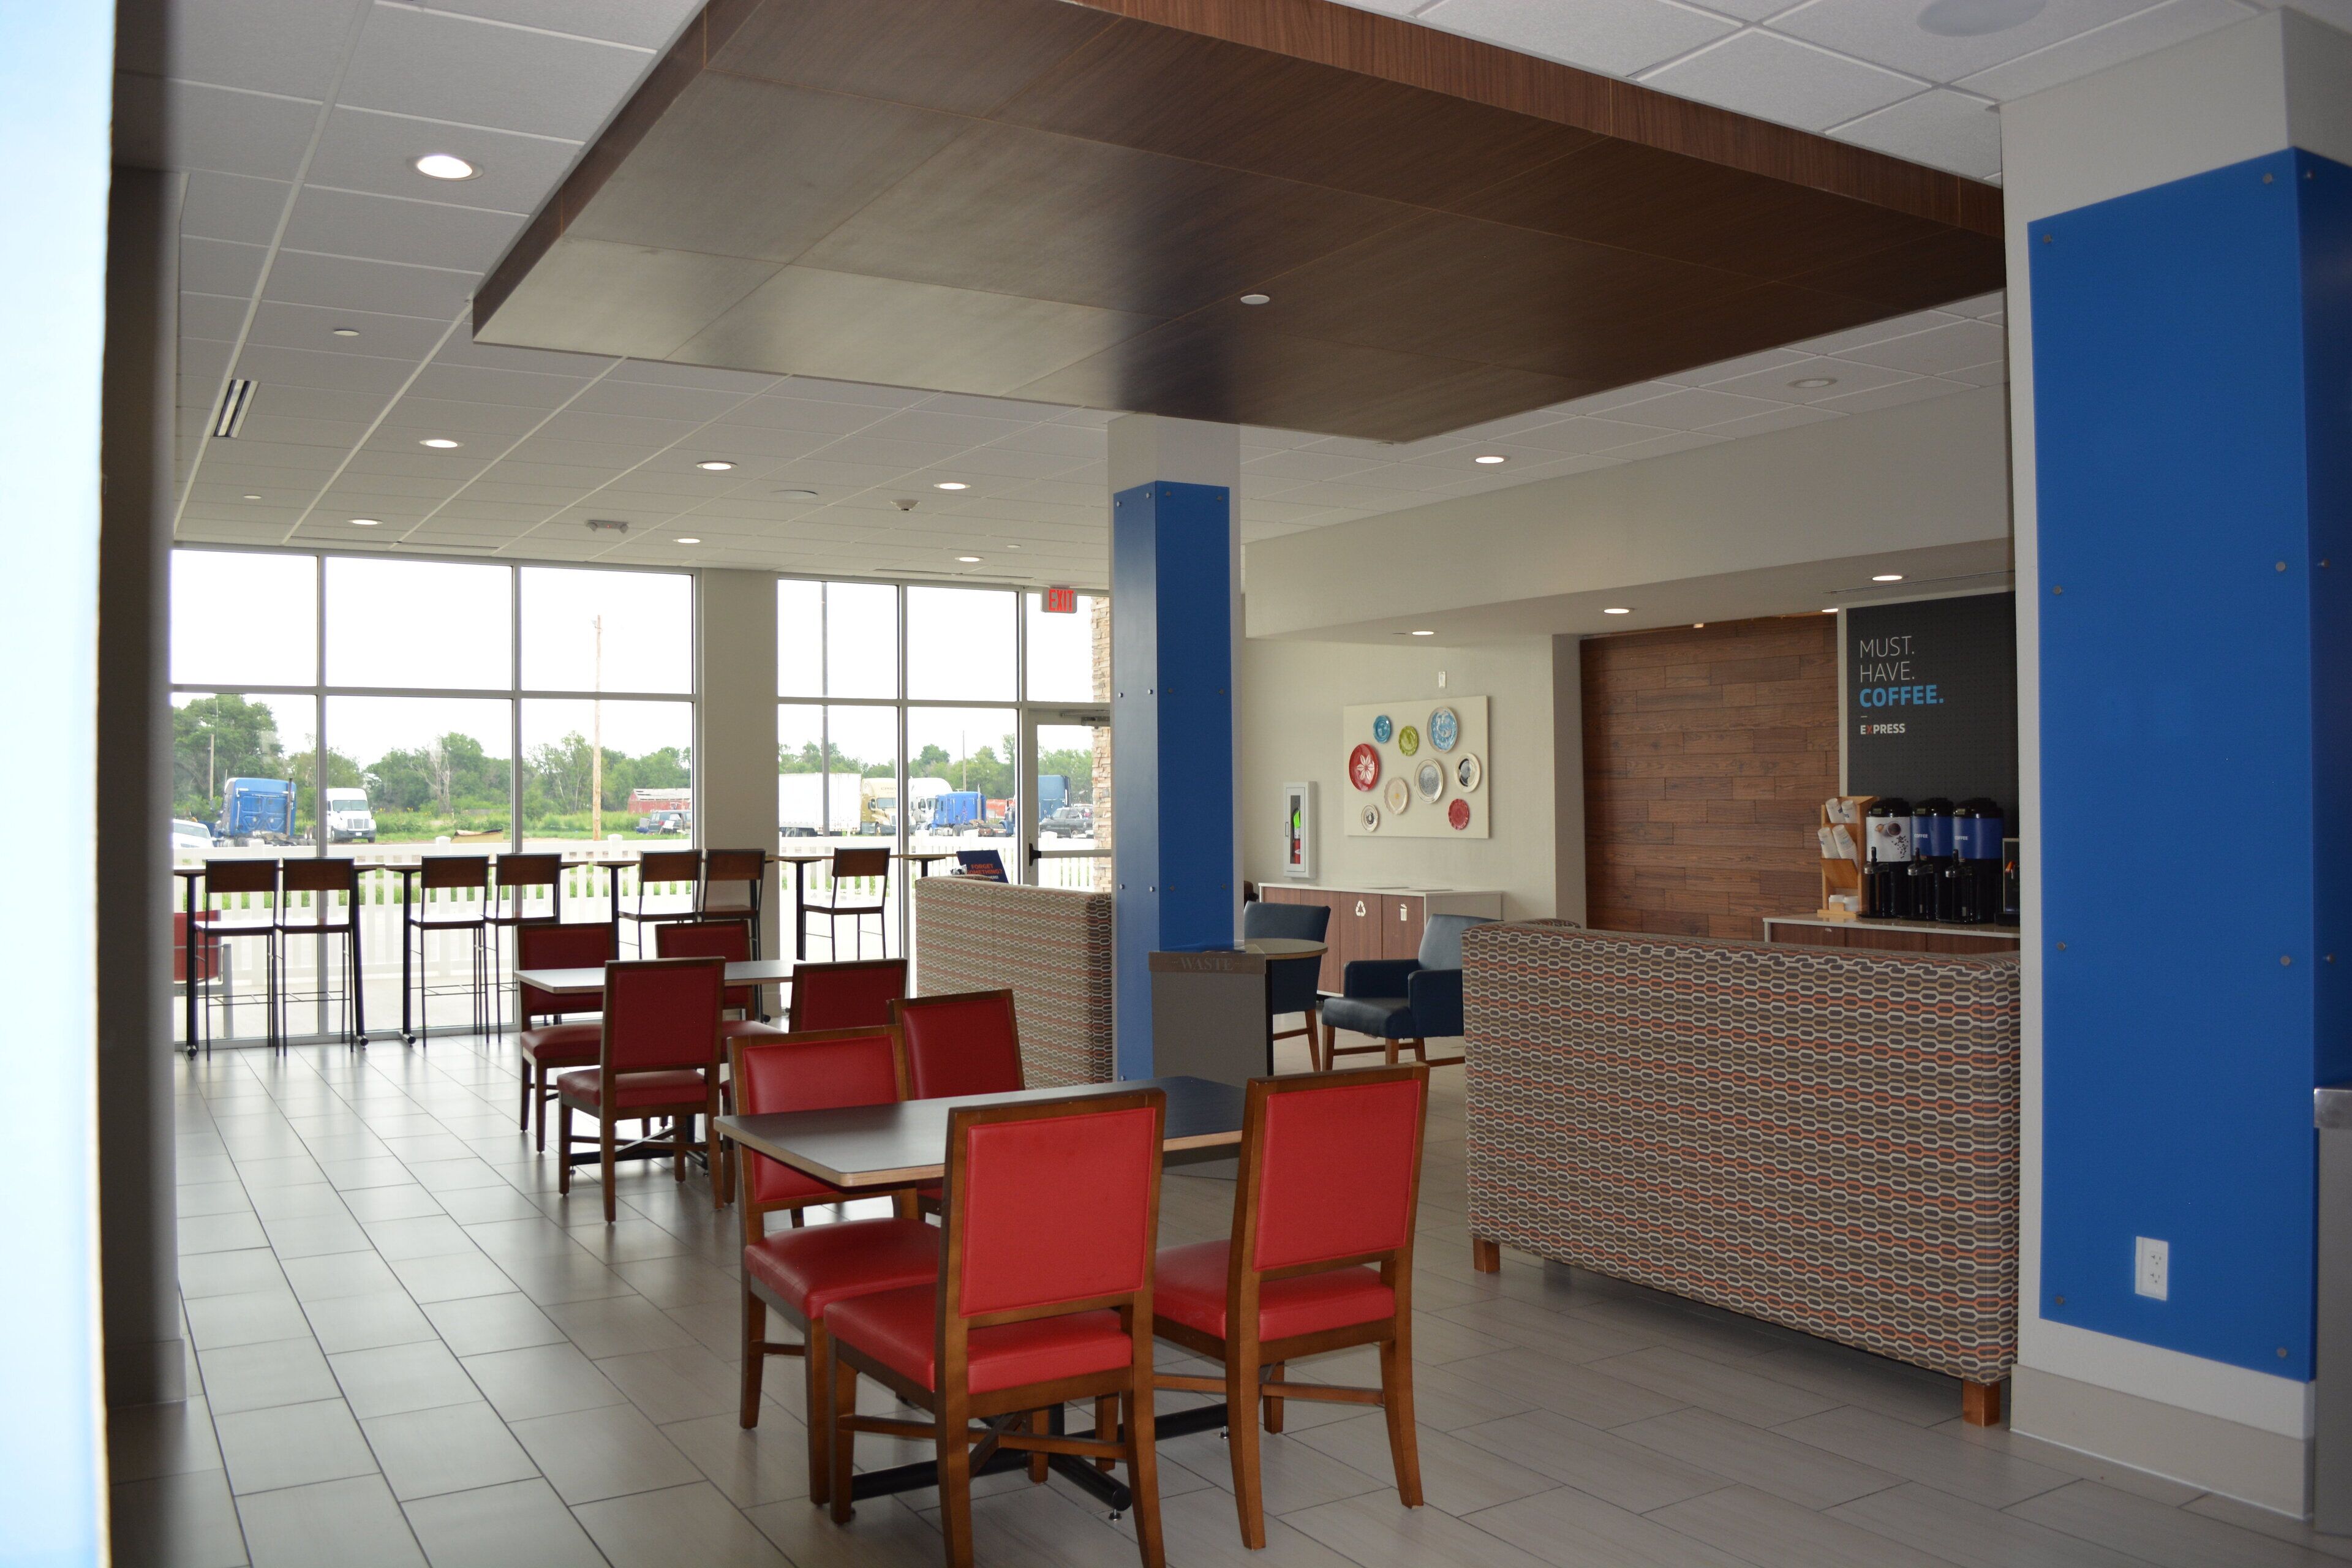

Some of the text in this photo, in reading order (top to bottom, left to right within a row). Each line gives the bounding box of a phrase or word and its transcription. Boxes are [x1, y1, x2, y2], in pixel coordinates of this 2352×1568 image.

[1049, 589, 1074, 612] EXIT
[1860, 636, 1915, 658] MUST.
[1860, 661, 1915, 683] HAVE.
[1859, 684, 1944, 707] COFFEE.
[1860, 723, 1905, 734] EXPRESS
[1179, 957, 1234, 971] WASTE
